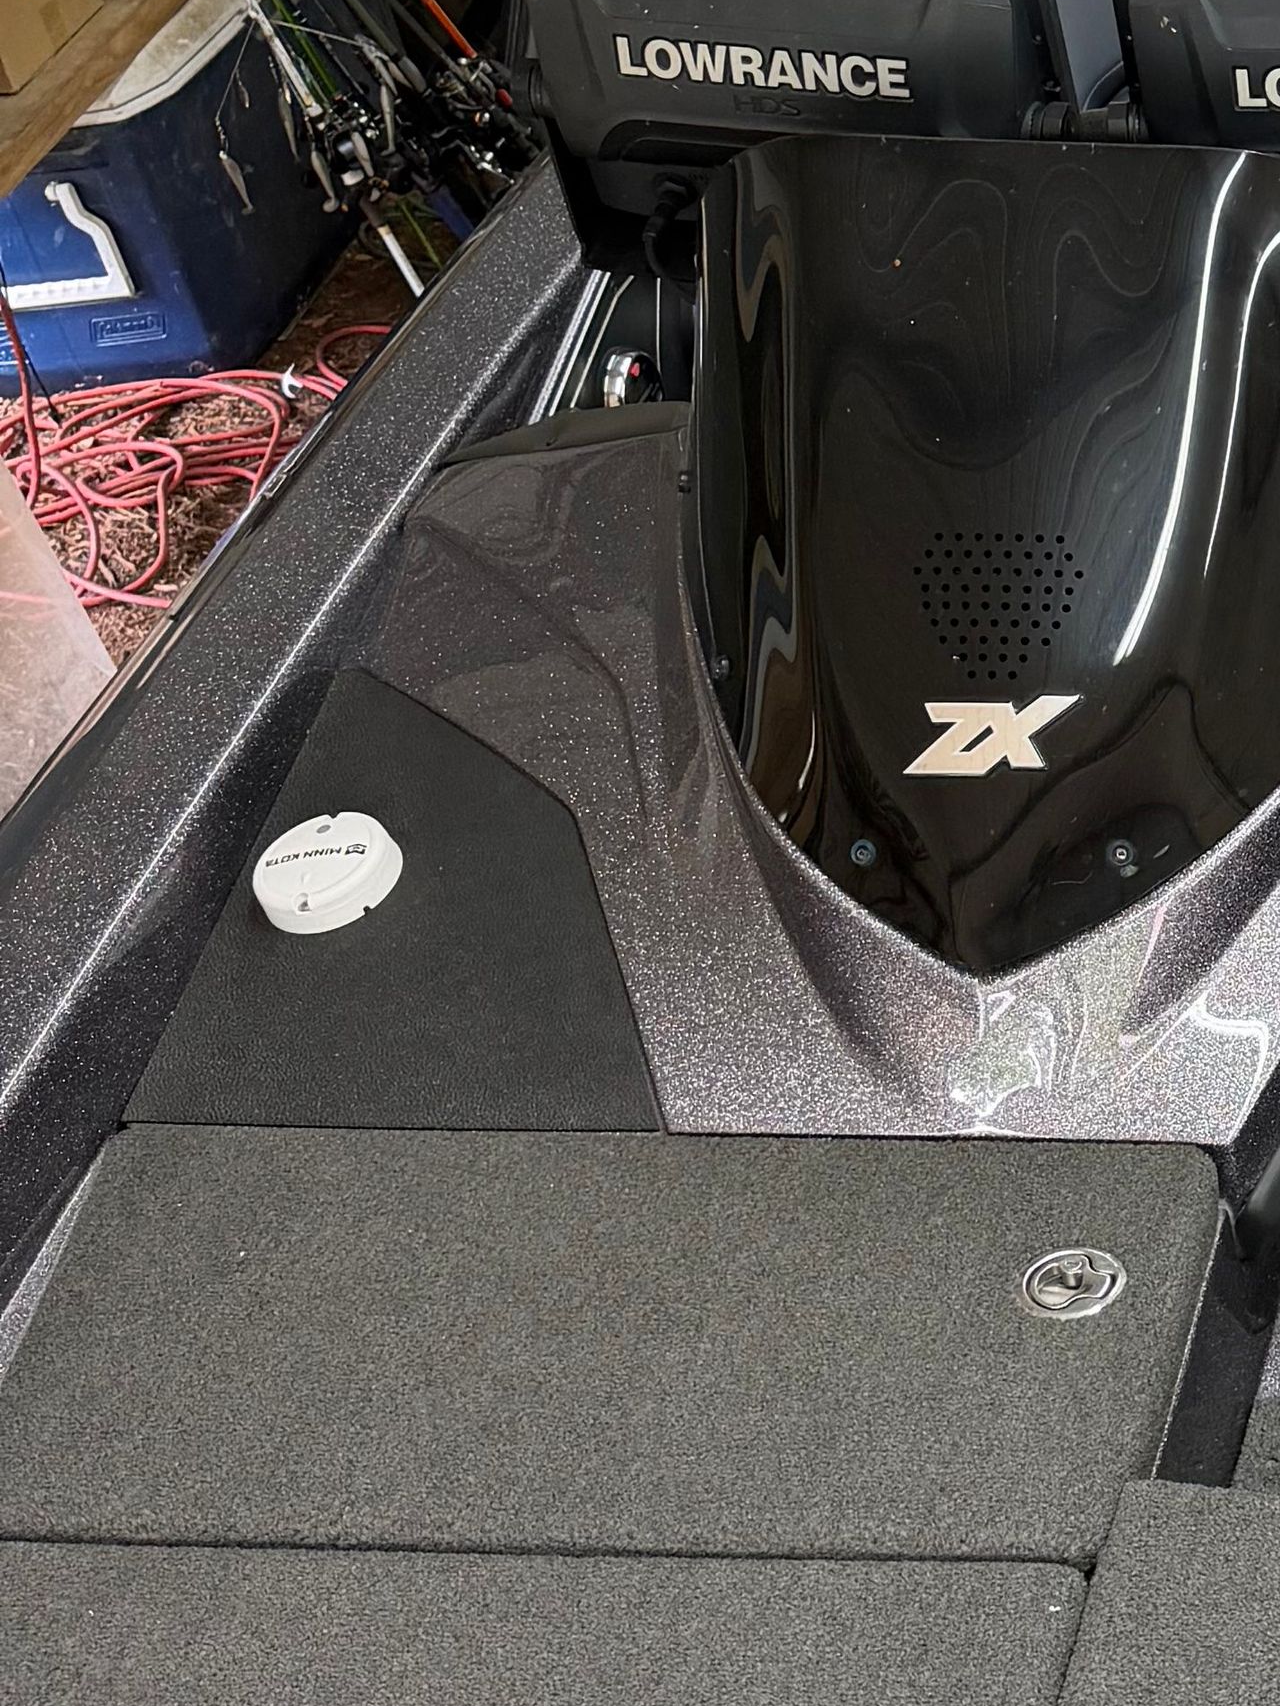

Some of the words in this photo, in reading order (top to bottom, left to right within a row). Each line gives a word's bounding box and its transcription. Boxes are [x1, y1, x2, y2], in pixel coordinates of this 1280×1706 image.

[614, 35, 911, 99] LOWRANCE
[734, 94, 800, 116] HDS
[903, 694, 1083, 777] ZX
[265, 852, 300, 868] KOTA
[303, 847, 342, 859] MINN
